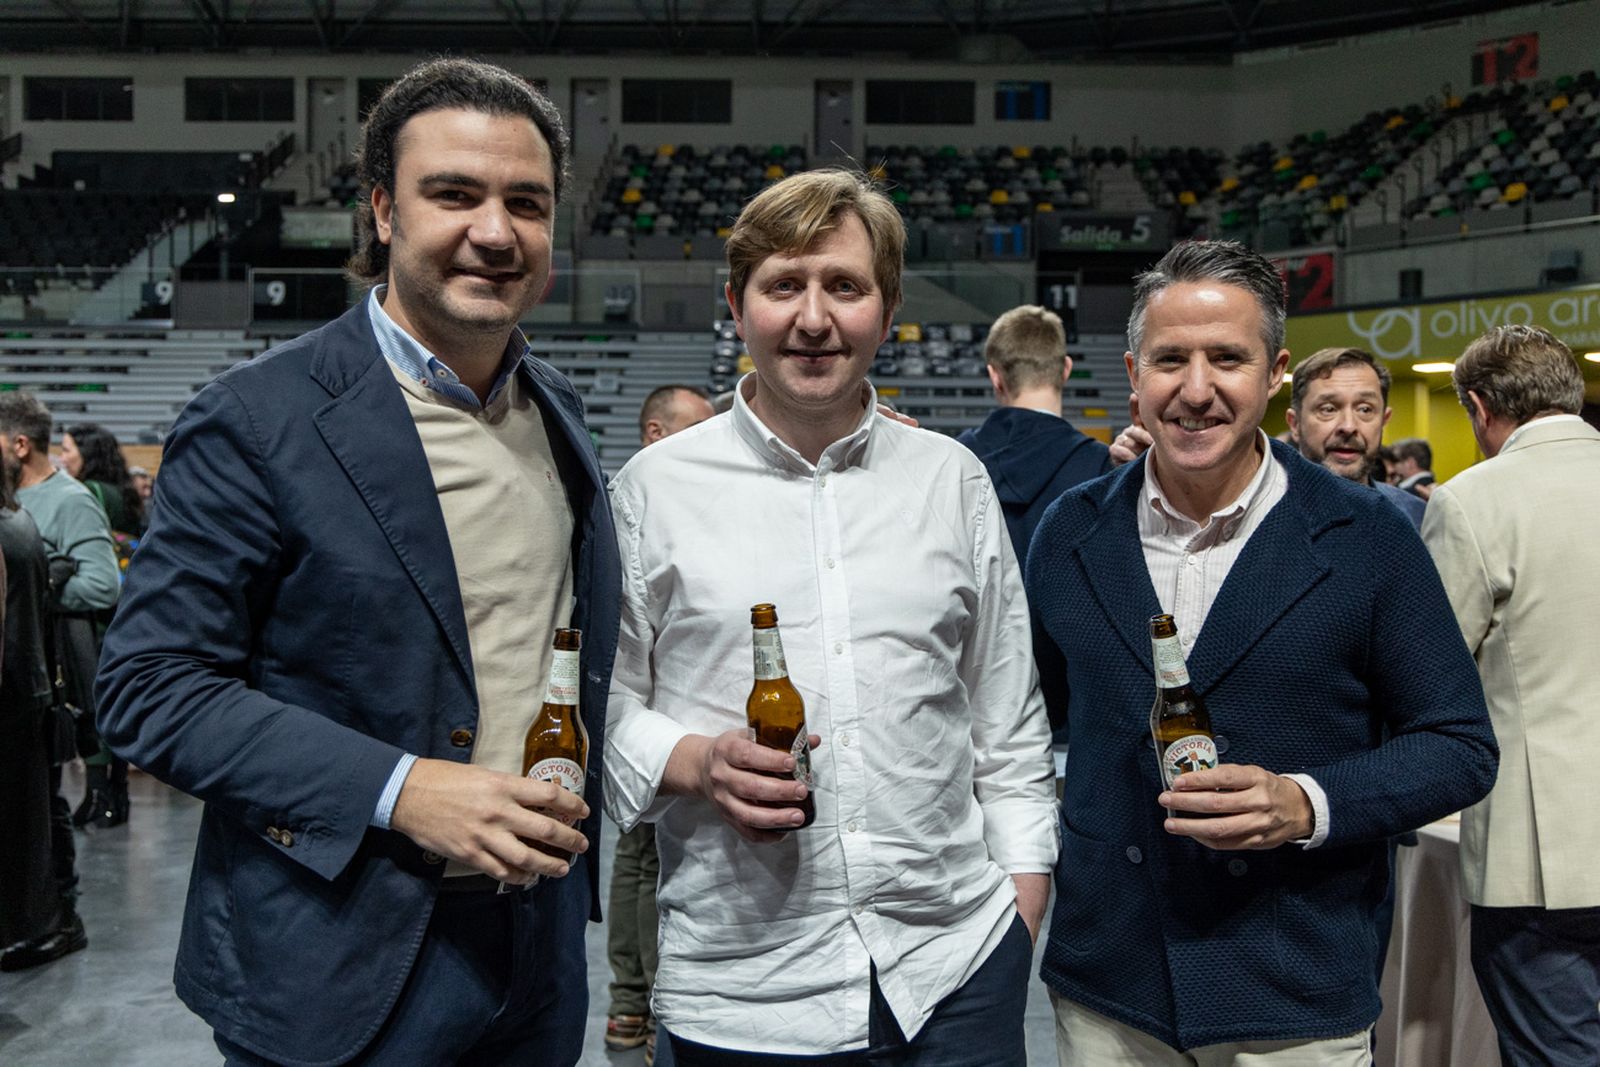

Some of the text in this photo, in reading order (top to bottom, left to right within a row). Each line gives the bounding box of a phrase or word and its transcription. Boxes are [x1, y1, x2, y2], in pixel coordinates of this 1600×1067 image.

[1475, 33, 1539, 85] 12
[1060, 215, 1152, 243] Salida 5
[155, 281, 173, 305] 9
[267, 281, 286, 305] 9
[1050, 284, 1078, 309] 11
[1430, 295, 1600, 338] olivo ar
[1169, 741, 1211, 763] VICTORIA
